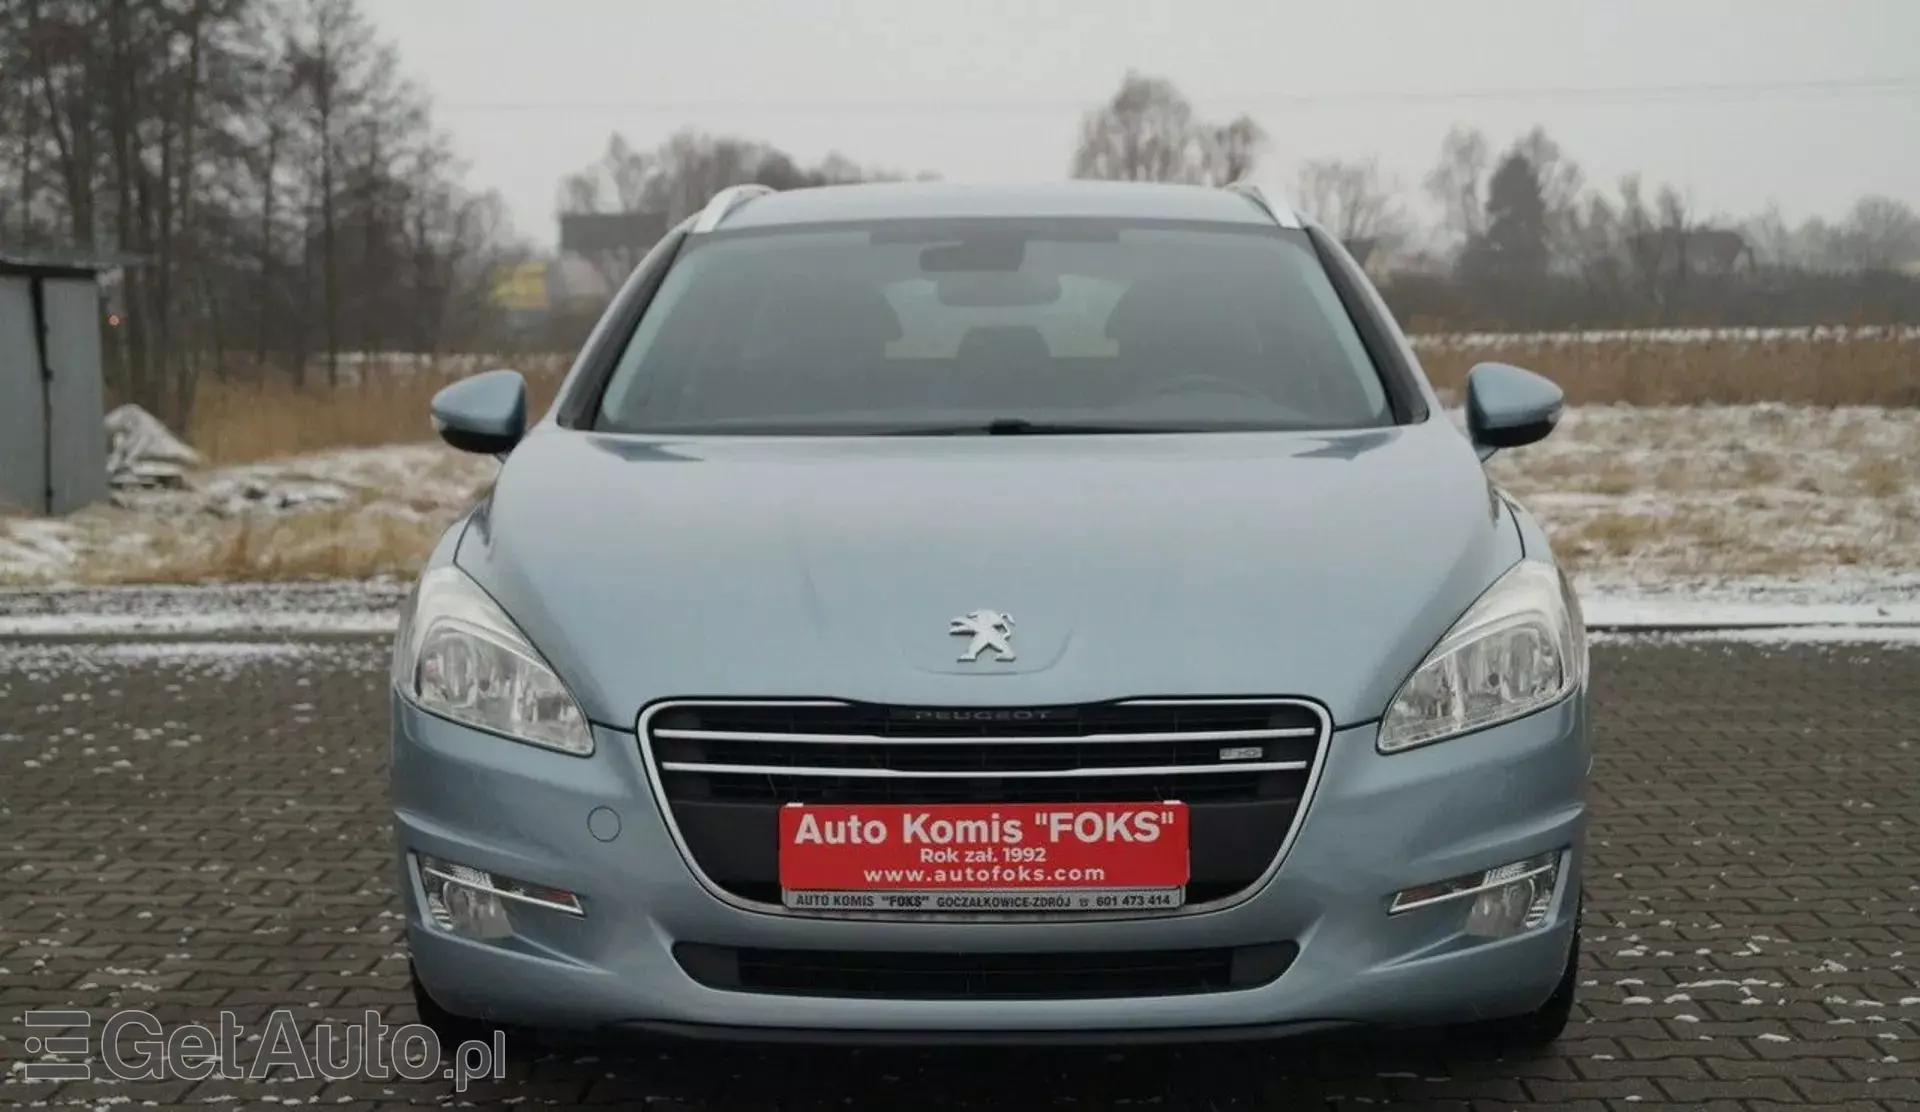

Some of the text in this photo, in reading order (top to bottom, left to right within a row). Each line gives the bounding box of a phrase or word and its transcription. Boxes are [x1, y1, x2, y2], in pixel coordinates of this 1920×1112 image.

[914, 710, 1052, 720] PEUGEOT
[794, 811, 1174, 845] Auto Komis "FOKS"
[920, 847, 1047, 863] Rok zał. 1992
[863, 865, 1105, 883] www.autofoks.com
[796, 895, 830, 906] AUTO
[833, 895, 874, 907] KOMIS
[882, 895, 929, 907] "FOKS"
[1096, 896, 1118, 906] 601
[1122, 896, 1144, 906] 473
[1149, 895, 1170, 905] 414
